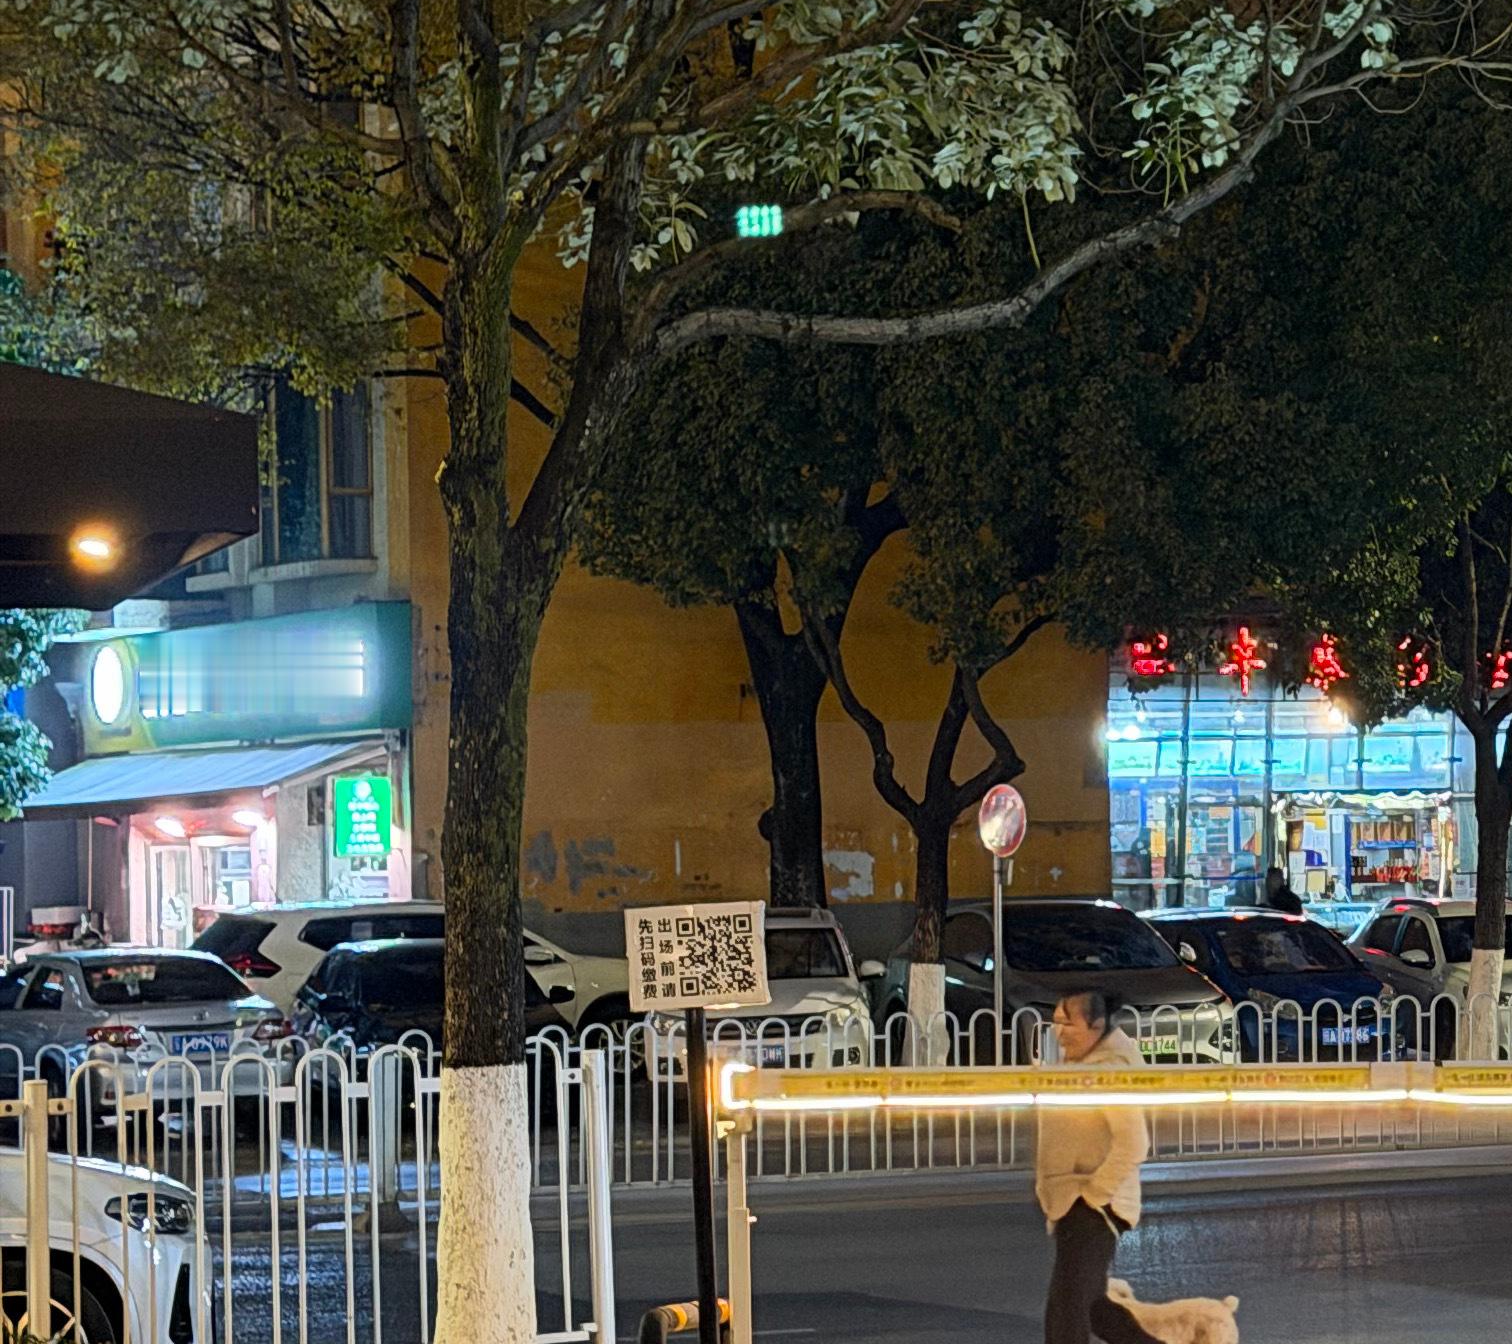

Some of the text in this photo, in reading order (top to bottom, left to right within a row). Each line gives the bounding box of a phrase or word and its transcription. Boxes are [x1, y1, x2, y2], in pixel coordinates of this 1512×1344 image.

[638, 918, 658, 1000] 先扫码缴费
[657, 918, 676, 998] 出场前请
